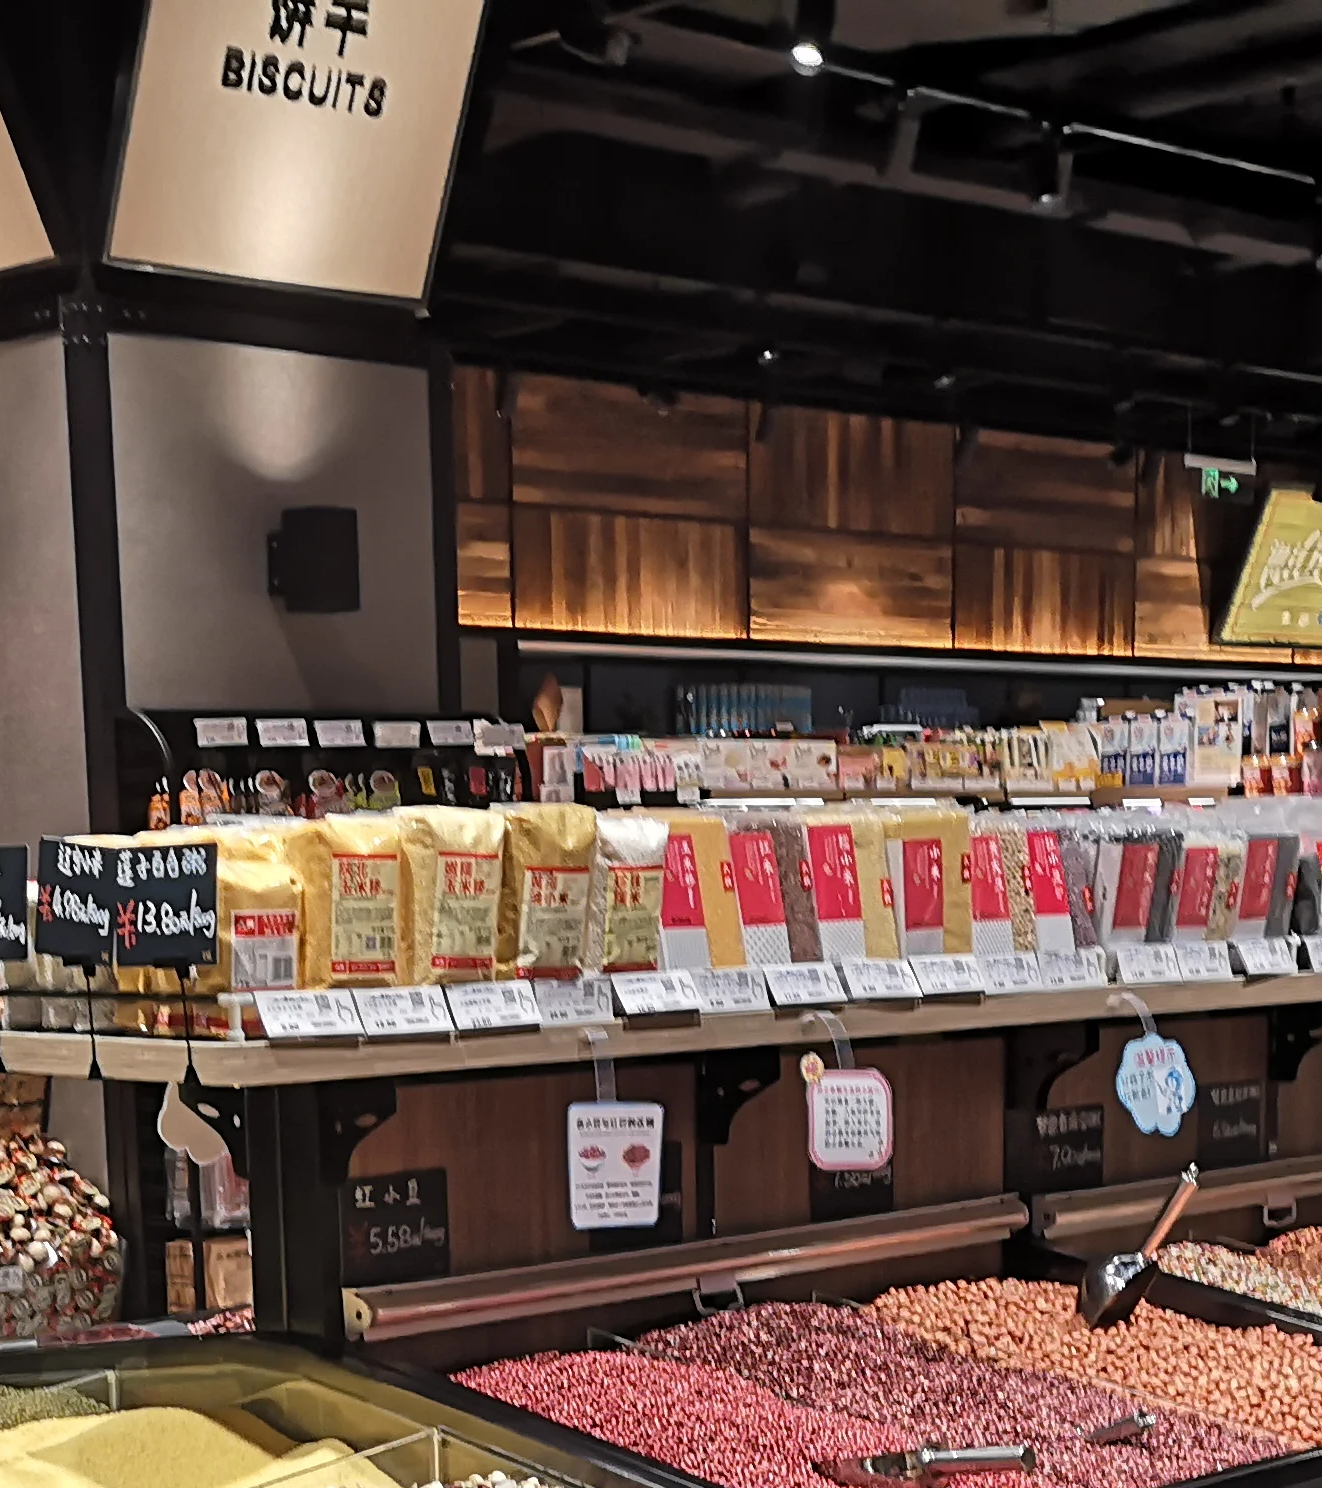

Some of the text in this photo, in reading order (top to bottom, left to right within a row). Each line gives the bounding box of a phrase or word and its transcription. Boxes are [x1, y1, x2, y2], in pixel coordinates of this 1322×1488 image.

[269, 0, 370, 57] 饼干
[221, 46, 388, 118] BISCUITS
[354, 1178, 422, 1209] 红小豆
